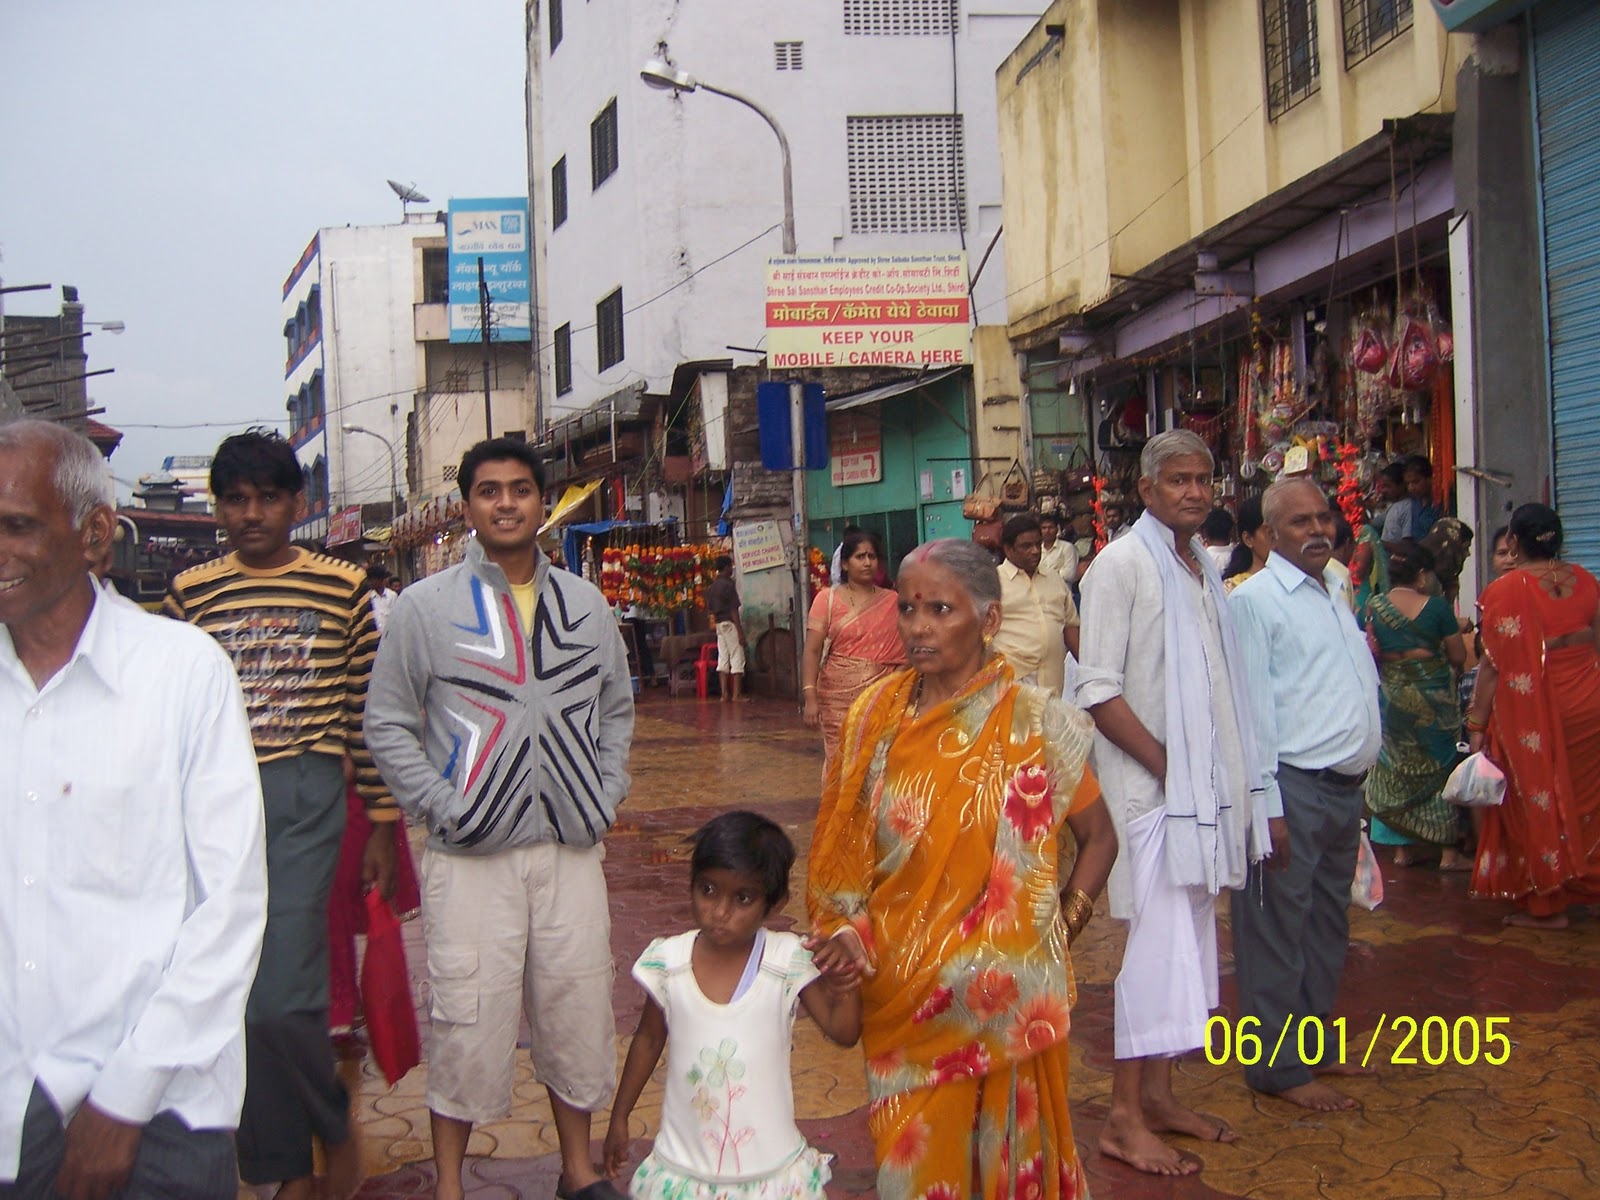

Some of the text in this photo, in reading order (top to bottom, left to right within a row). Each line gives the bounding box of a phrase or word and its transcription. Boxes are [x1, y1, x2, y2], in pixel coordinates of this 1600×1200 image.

[787, 286, 797, 296] Sai
[829, 284, 864, 297] Employees
[865, 284, 885, 294] Credit
[916, 300, 960, 319] ठेवावा
[822, 330, 915, 345] KEEP YOUR
[774, 352, 835, 366] MOBILE
[848, 350, 916, 365] CAMERA
[921, 349, 964, 363] HERE
